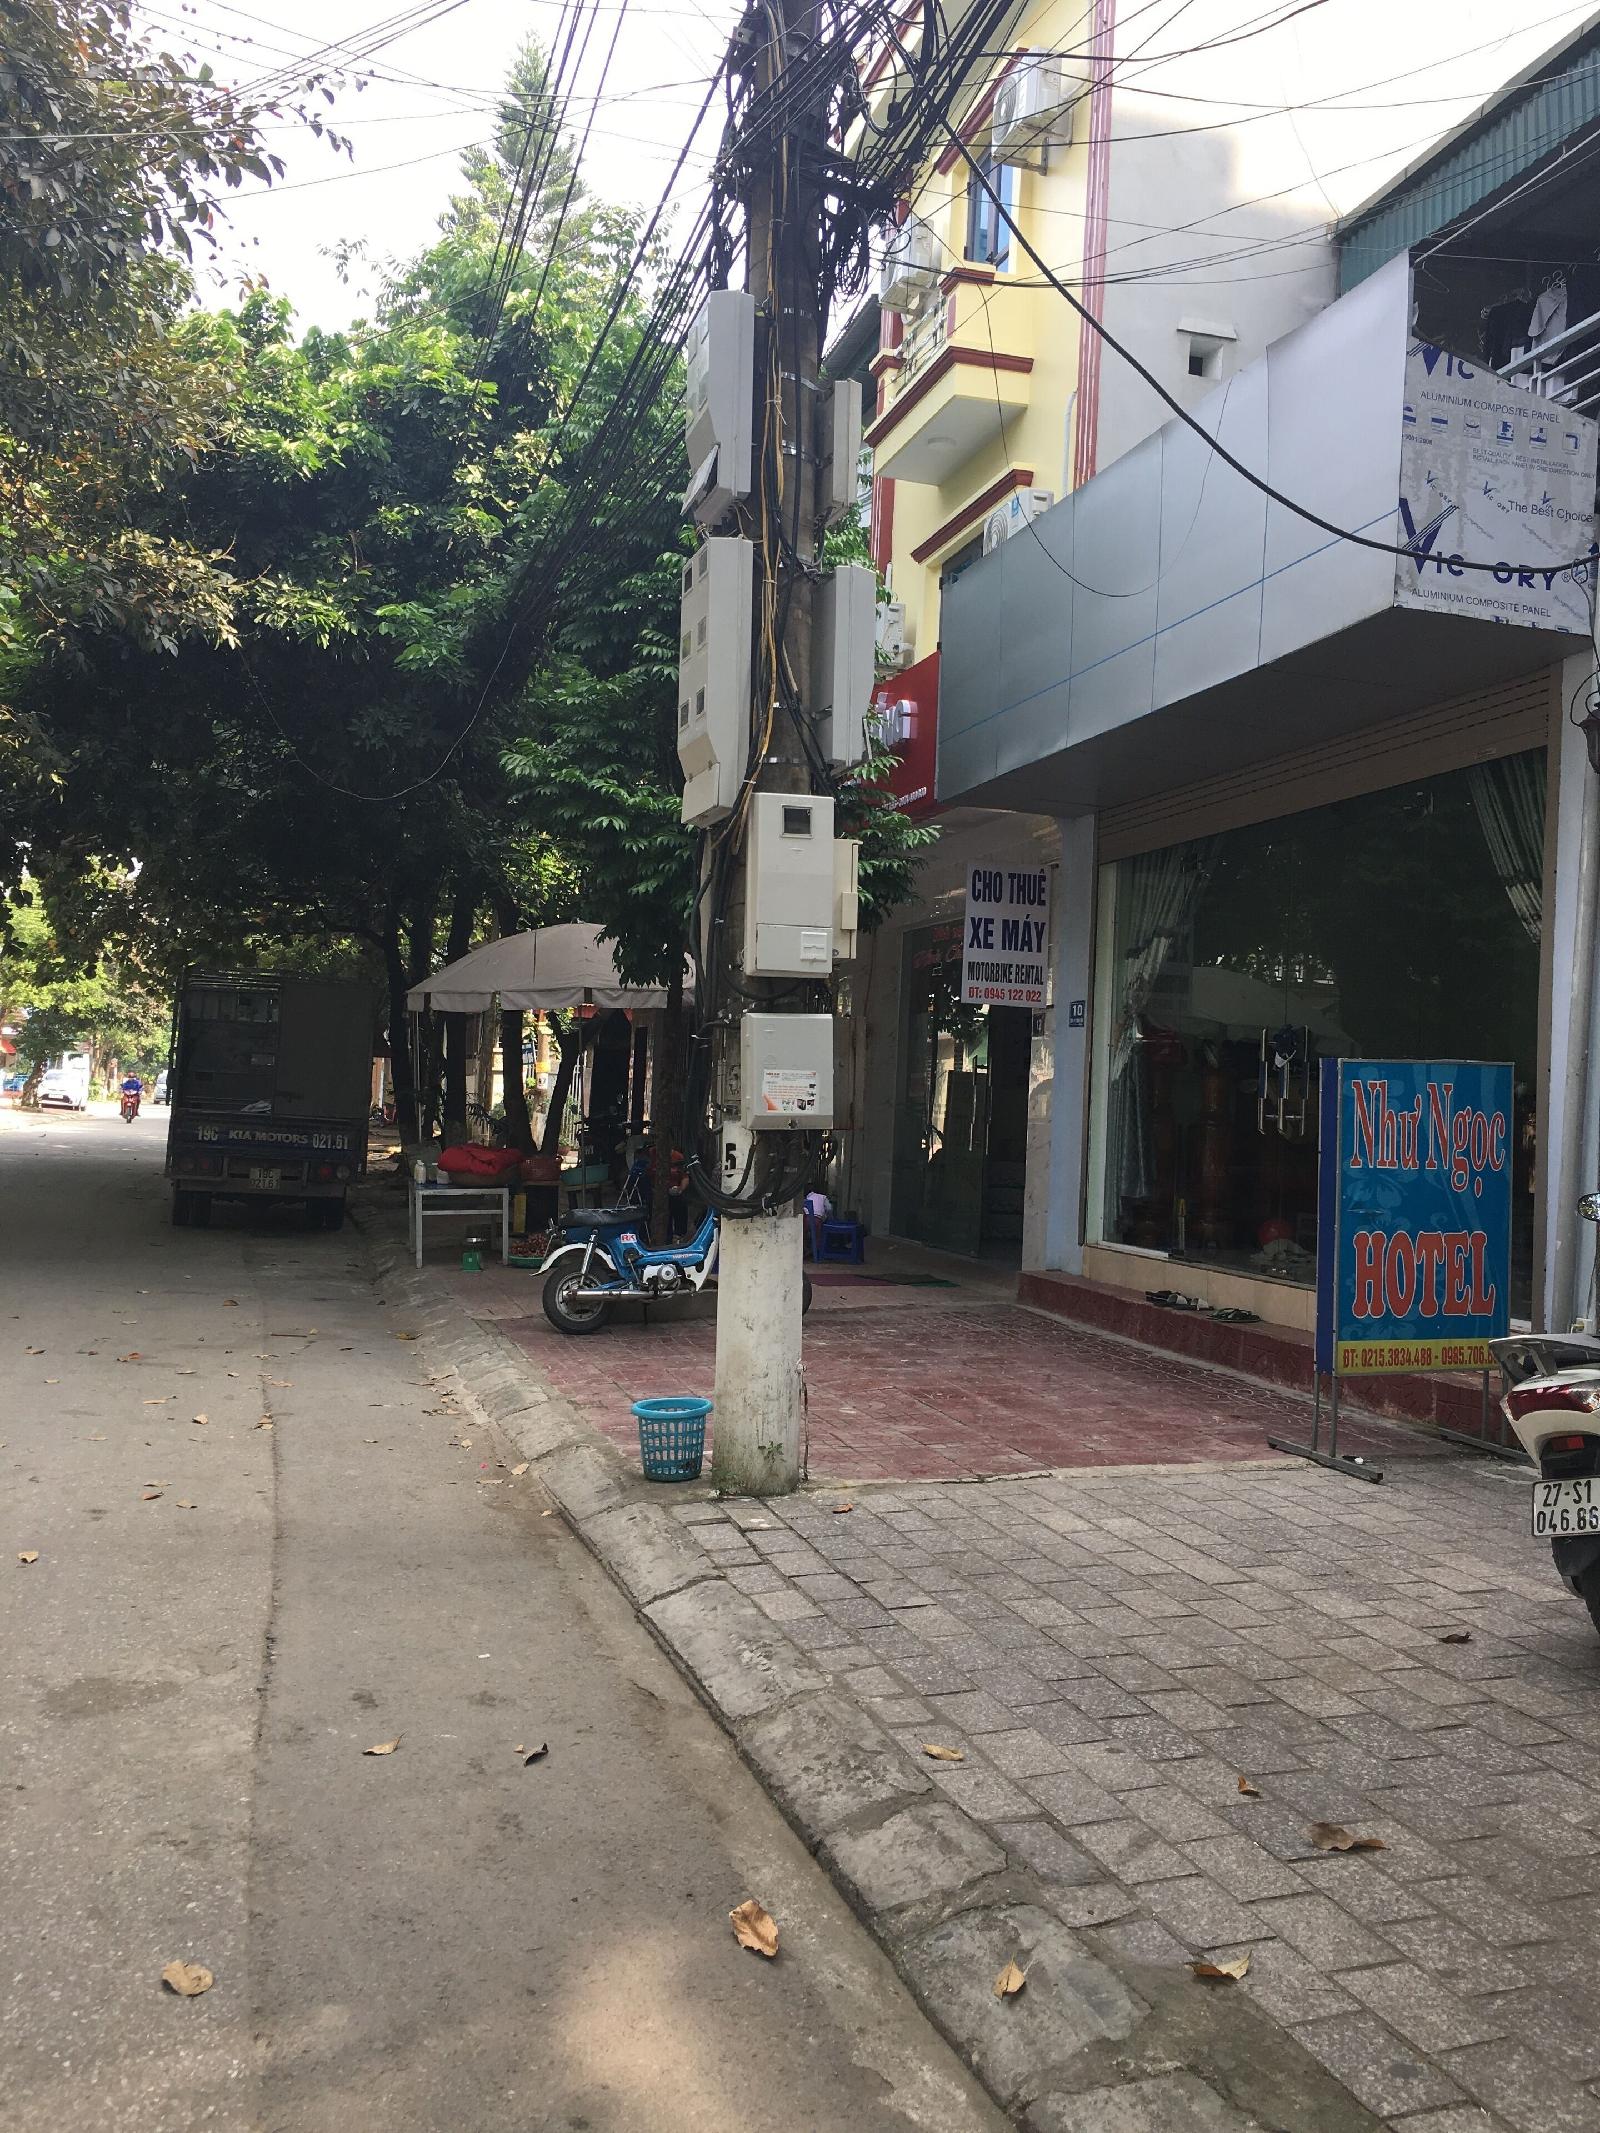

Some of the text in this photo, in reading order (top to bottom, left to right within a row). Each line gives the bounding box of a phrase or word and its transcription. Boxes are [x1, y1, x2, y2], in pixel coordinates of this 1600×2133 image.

[1420, 390, 1561, 424] ALUMINIUM COMPOSITE PANEL
[1507, 500, 1528, 514] The
[1530, 503, 1554, 518] Best
[1556, 508, 1594, 522] Choice
[1411, 588, 1464, 604] ALUMINIUM
[1465, 596, 1520, 613] COMPOSITE
[1522, 604, 1552, 618] PANEL
[972, 868, 1047, 906] CHO THUÊ
[968, 916, 995, 950] XE
[1001, 914, 1046, 953] MÁY
[967, 960, 1044, 986] MOTORBIKE RENTAL
[983, 987, 1005, 1001] 0945
[1007, 988, 1023, 1001] 122
[1025, 989, 1042, 1002] 022
[1072, 1004, 1083, 1017] 10
[228, 1129, 252, 1140] KIA
[255, 1131, 309, 1144] MOTORS
[312, 1133, 349, 1150] 021.61
[1350, 1079, 1506, 1198] Như Ngọc
[1352, 1230, 1496, 1319] HOTEL
[1361, 1347, 1433, 1368] 0215.3834.488
[1542, 1480, 1592, 1507] 27-S1
[1536, 1506, 1599, 1533] 046.86
